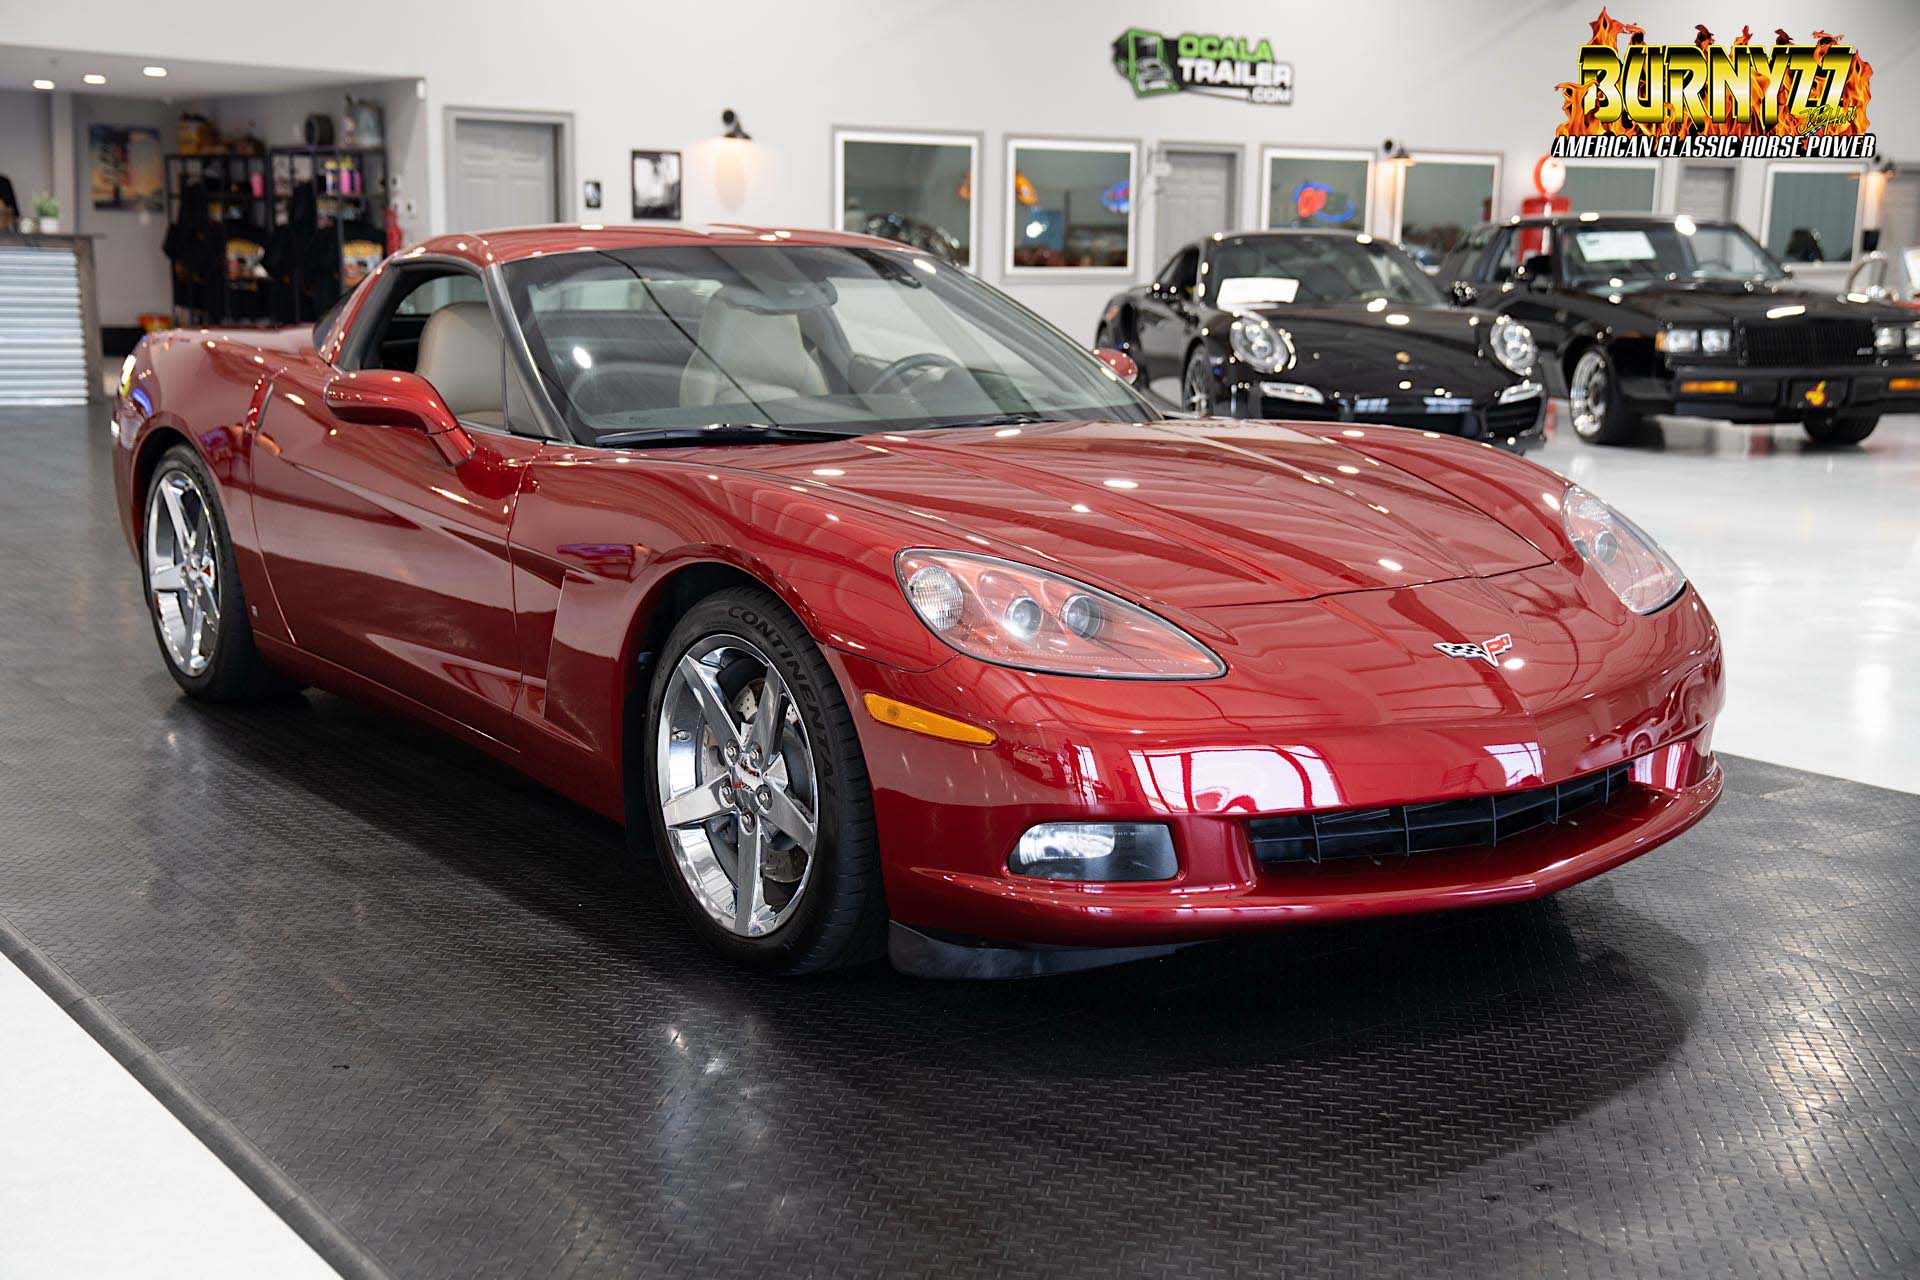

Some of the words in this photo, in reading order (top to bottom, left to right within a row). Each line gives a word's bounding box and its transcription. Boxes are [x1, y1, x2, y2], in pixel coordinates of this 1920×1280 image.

[1178, 35, 1274, 62] OCALA
[1177, 57, 1292, 87] TRAILER
[728, 606, 837, 798] CONTINENTAL
